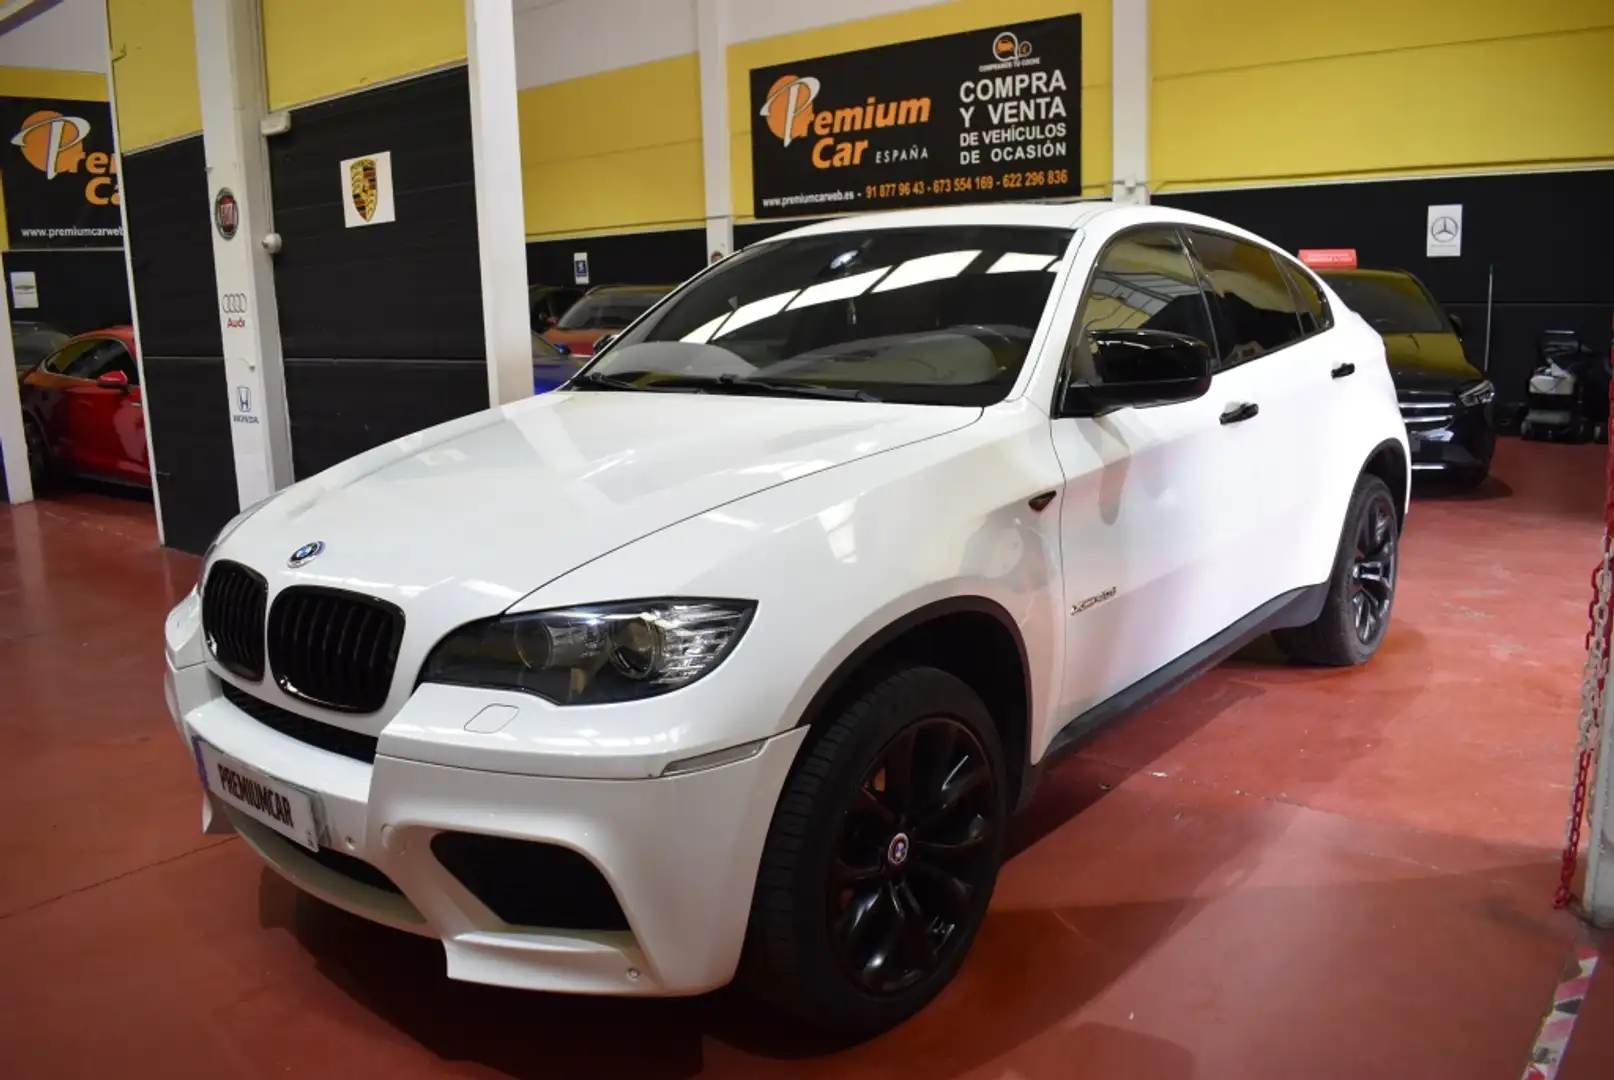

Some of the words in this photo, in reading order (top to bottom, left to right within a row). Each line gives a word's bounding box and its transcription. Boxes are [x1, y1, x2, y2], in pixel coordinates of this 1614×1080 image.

[960, 69, 1067, 103] COMPRA
[760, 75, 931, 148] Premium
[959, 106, 975, 128] Y
[987, 96, 1067, 125] VENTA
[960, 132, 979, 147] DE
[982, 122, 1067, 145] VEHÍCULOS
[811, 137, 869, 169] Car
[875, 144, 929, 164] ESPAÑA
[960, 150, 980, 165] DE
[990, 139, 1066, 162] OCASIÓN
[762, 188, 855, 207] www.premiumcarweb.es
[865, 184, 877, 199] 91
[912, 180, 925, 195] 43
[933, 179, 951, 194] 673
[954, 177, 972, 192] 554
[974, 175, 994, 190] 169
[1002, 173, 1022, 188] 622
[226, 316, 246, 329] Audi
[217, 762, 295, 829] PREMIUMCAR
